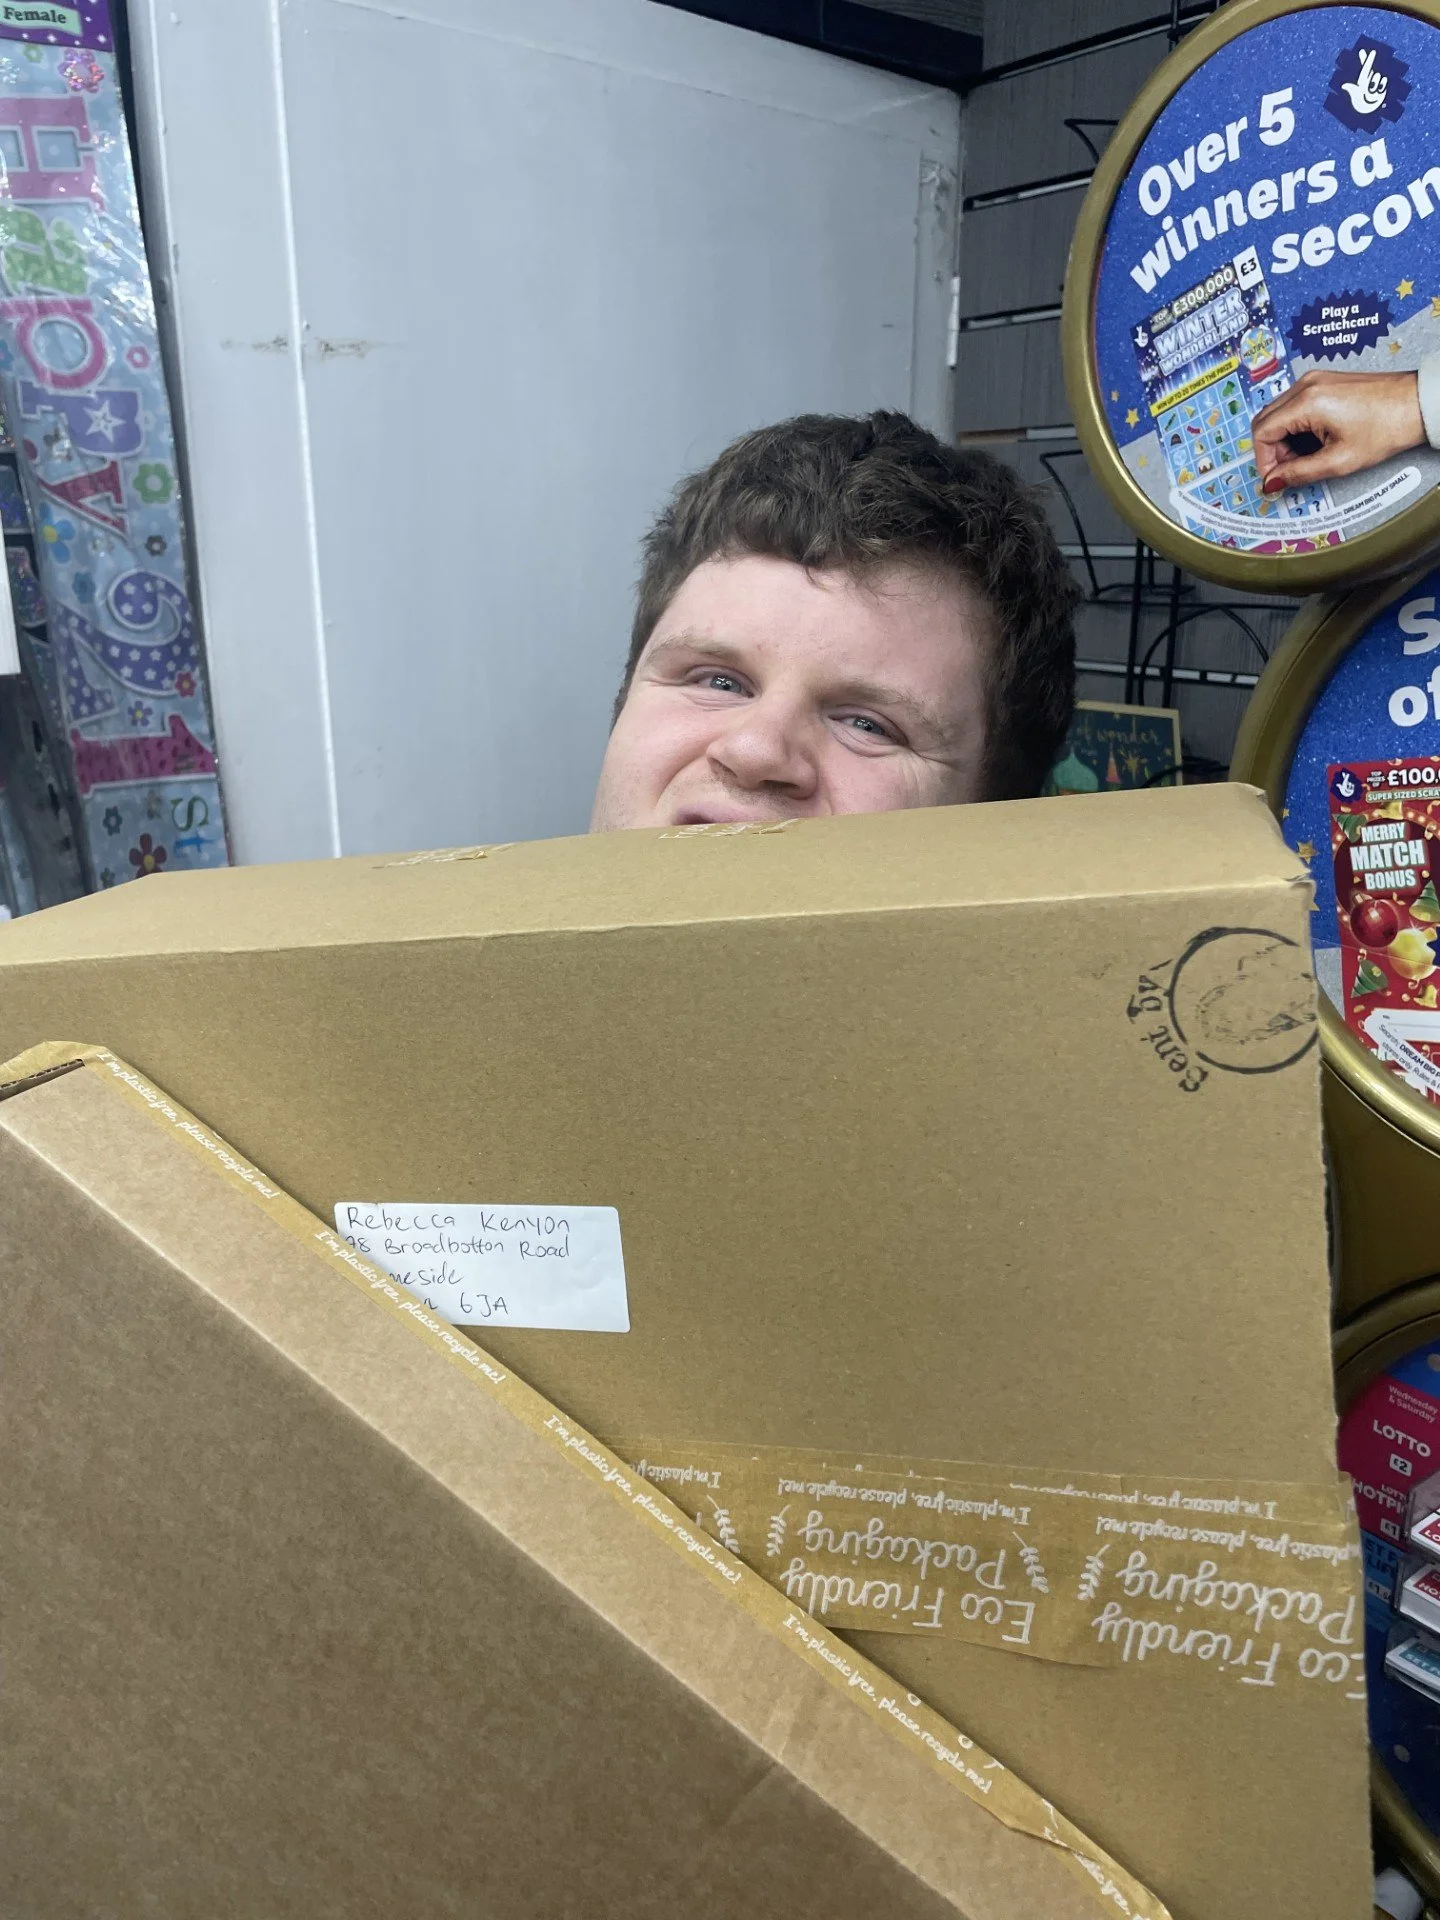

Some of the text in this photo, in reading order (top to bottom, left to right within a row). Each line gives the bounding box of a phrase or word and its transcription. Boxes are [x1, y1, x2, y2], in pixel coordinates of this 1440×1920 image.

[3, 6, 67, 24] Female
[1138, 87, 1295, 216] Over 5
[1129, 138, 1393, 293] winners a
[1240, 257, 1257, 277] £3
[1173, 267, 1234, 316] £300,000
[1156, 289, 1244, 357] WINTER
[1302, 312, 1379, 336] Scratchcard
[1321, 304, 1360, 319] Play a
[1160, 312, 1248, 373] WONDERLAND
[1322, 332, 1358, 346] today
[1367, 790, 1393, 801] SUPER
[1394, 788, 1417, 799] SIZED
[1361, 821, 1406, 843] MERRY
[1350, 839, 1425, 871] MATCH
[1364, 869, 1417, 890] BONUS
[1399, 1043, 1425, 1066] DREAM
[1423, 1062, 1437, 1076] BIG
[347, 1206, 570, 1236] Rebecca Kenyon
[518, 1235, 570, 1260] Road
[315, 1230, 340, 1253] I'm
[334, 1249, 378, 1282] plastic
[398, 1300, 440, 1334] please
[437, 1329, 480, 1366] recycle
[478, 1362, 506, 1385] me!
[1388, 1384, 1438, 1416] Wednesday
[1397, 1398, 1436, 1424] Saturday
[1372, 1419, 1432, 1458] LOTTO
[543, 1414, 570, 1441] I'm
[565, 1438, 609, 1473] plastic
[632, 1493, 674, 1528] please
[671, 1525, 715, 1565] recycle
[714, 1560, 742, 1585] me!
[777, 1477, 806, 1496] me!
[858, 1487, 908, 1510] please
[999, 1506, 1032, 1526] I'm
[1129, 1518, 1191, 1541] recycle
[797, 1508, 1006, 1591] Packaging
[1191, 1527, 1247, 1552] please
[780, 1557, 1036, 1645] Eco Friendly
[1116, 1550, 1355, 1645] Packaging
[1091, 1602, 1281, 1687] Friendly
[782, 1612, 809, 1641] I'm
[877, 1696, 921, 1735] please
[919, 1730, 965, 1772] recycle
